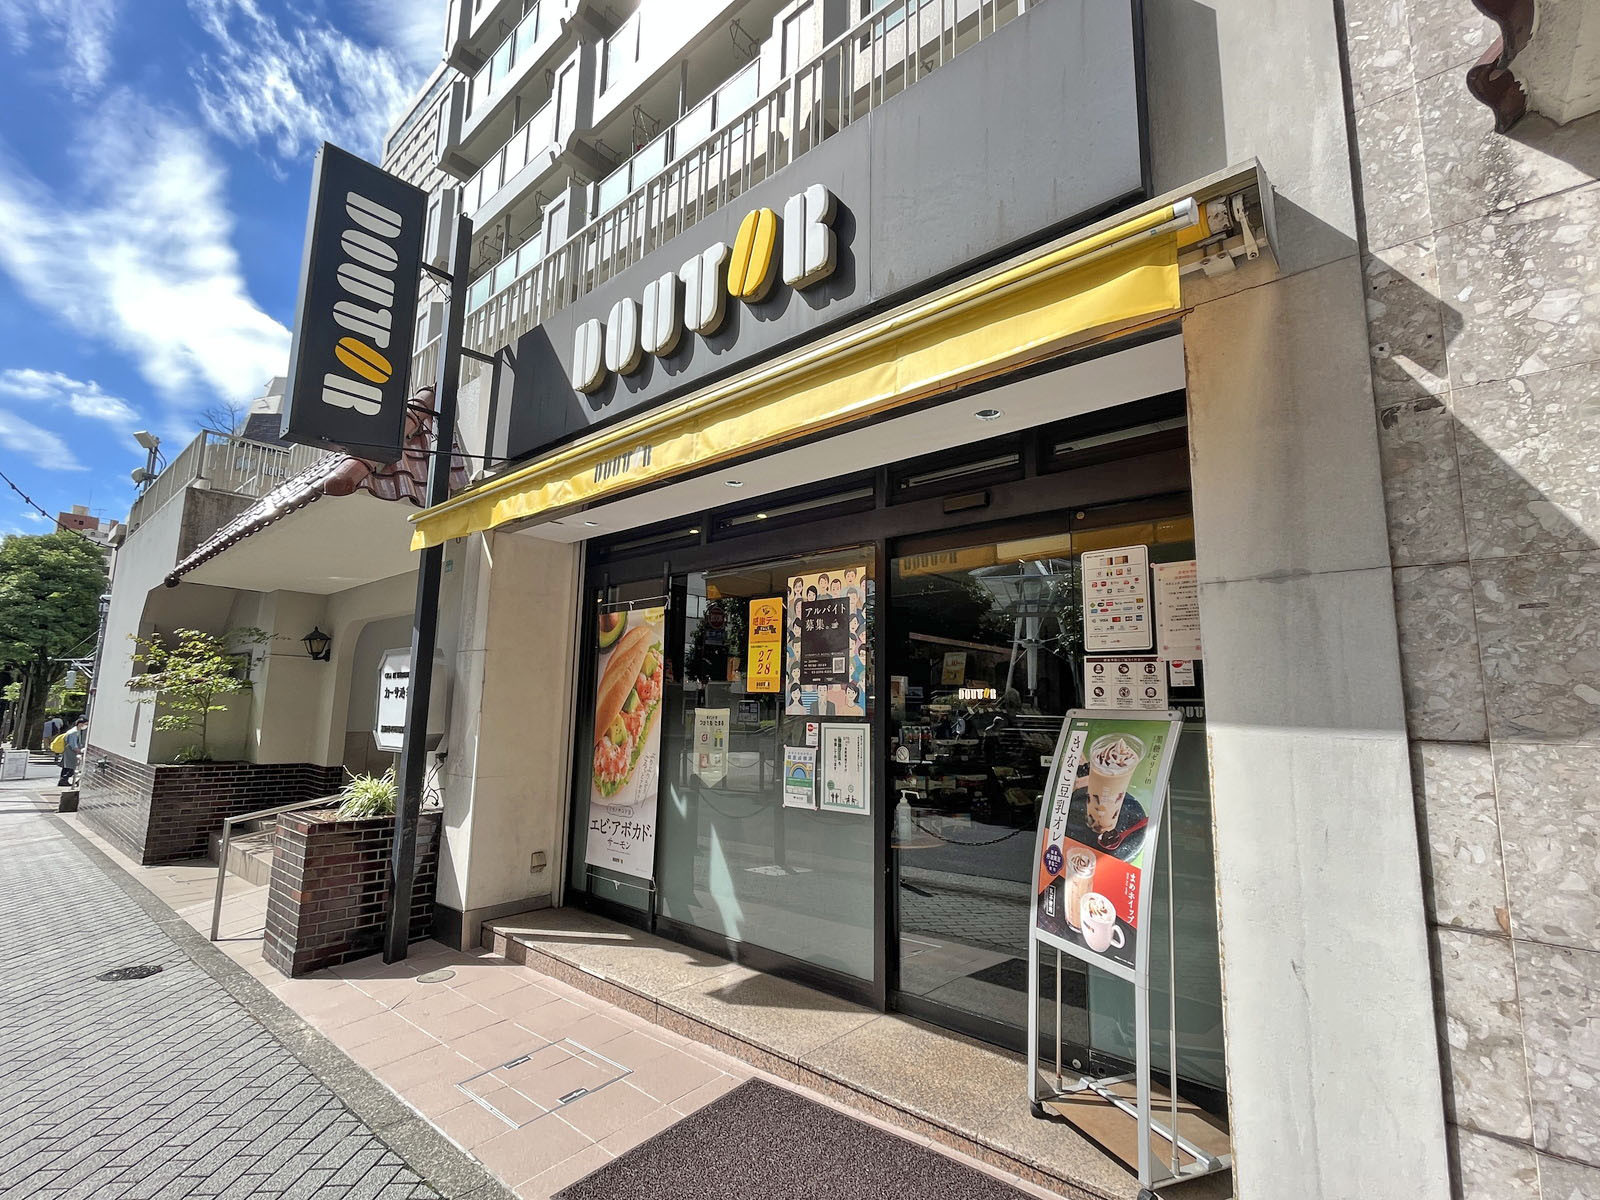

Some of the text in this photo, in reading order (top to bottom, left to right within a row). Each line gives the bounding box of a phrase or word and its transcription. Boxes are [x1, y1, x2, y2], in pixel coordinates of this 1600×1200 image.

[572, 183, 838, 395] DOUTOR
[321, 191, 403, 417] DOUTOR
[805, 603, 846, 618] アルバイト
[757, 649, 773, 663] 27
[756, 662, 771, 675] 28
[958, 687, 997, 700] DOUTOR
[1052, 735, 1082, 842] きなこ豆乳オレ
